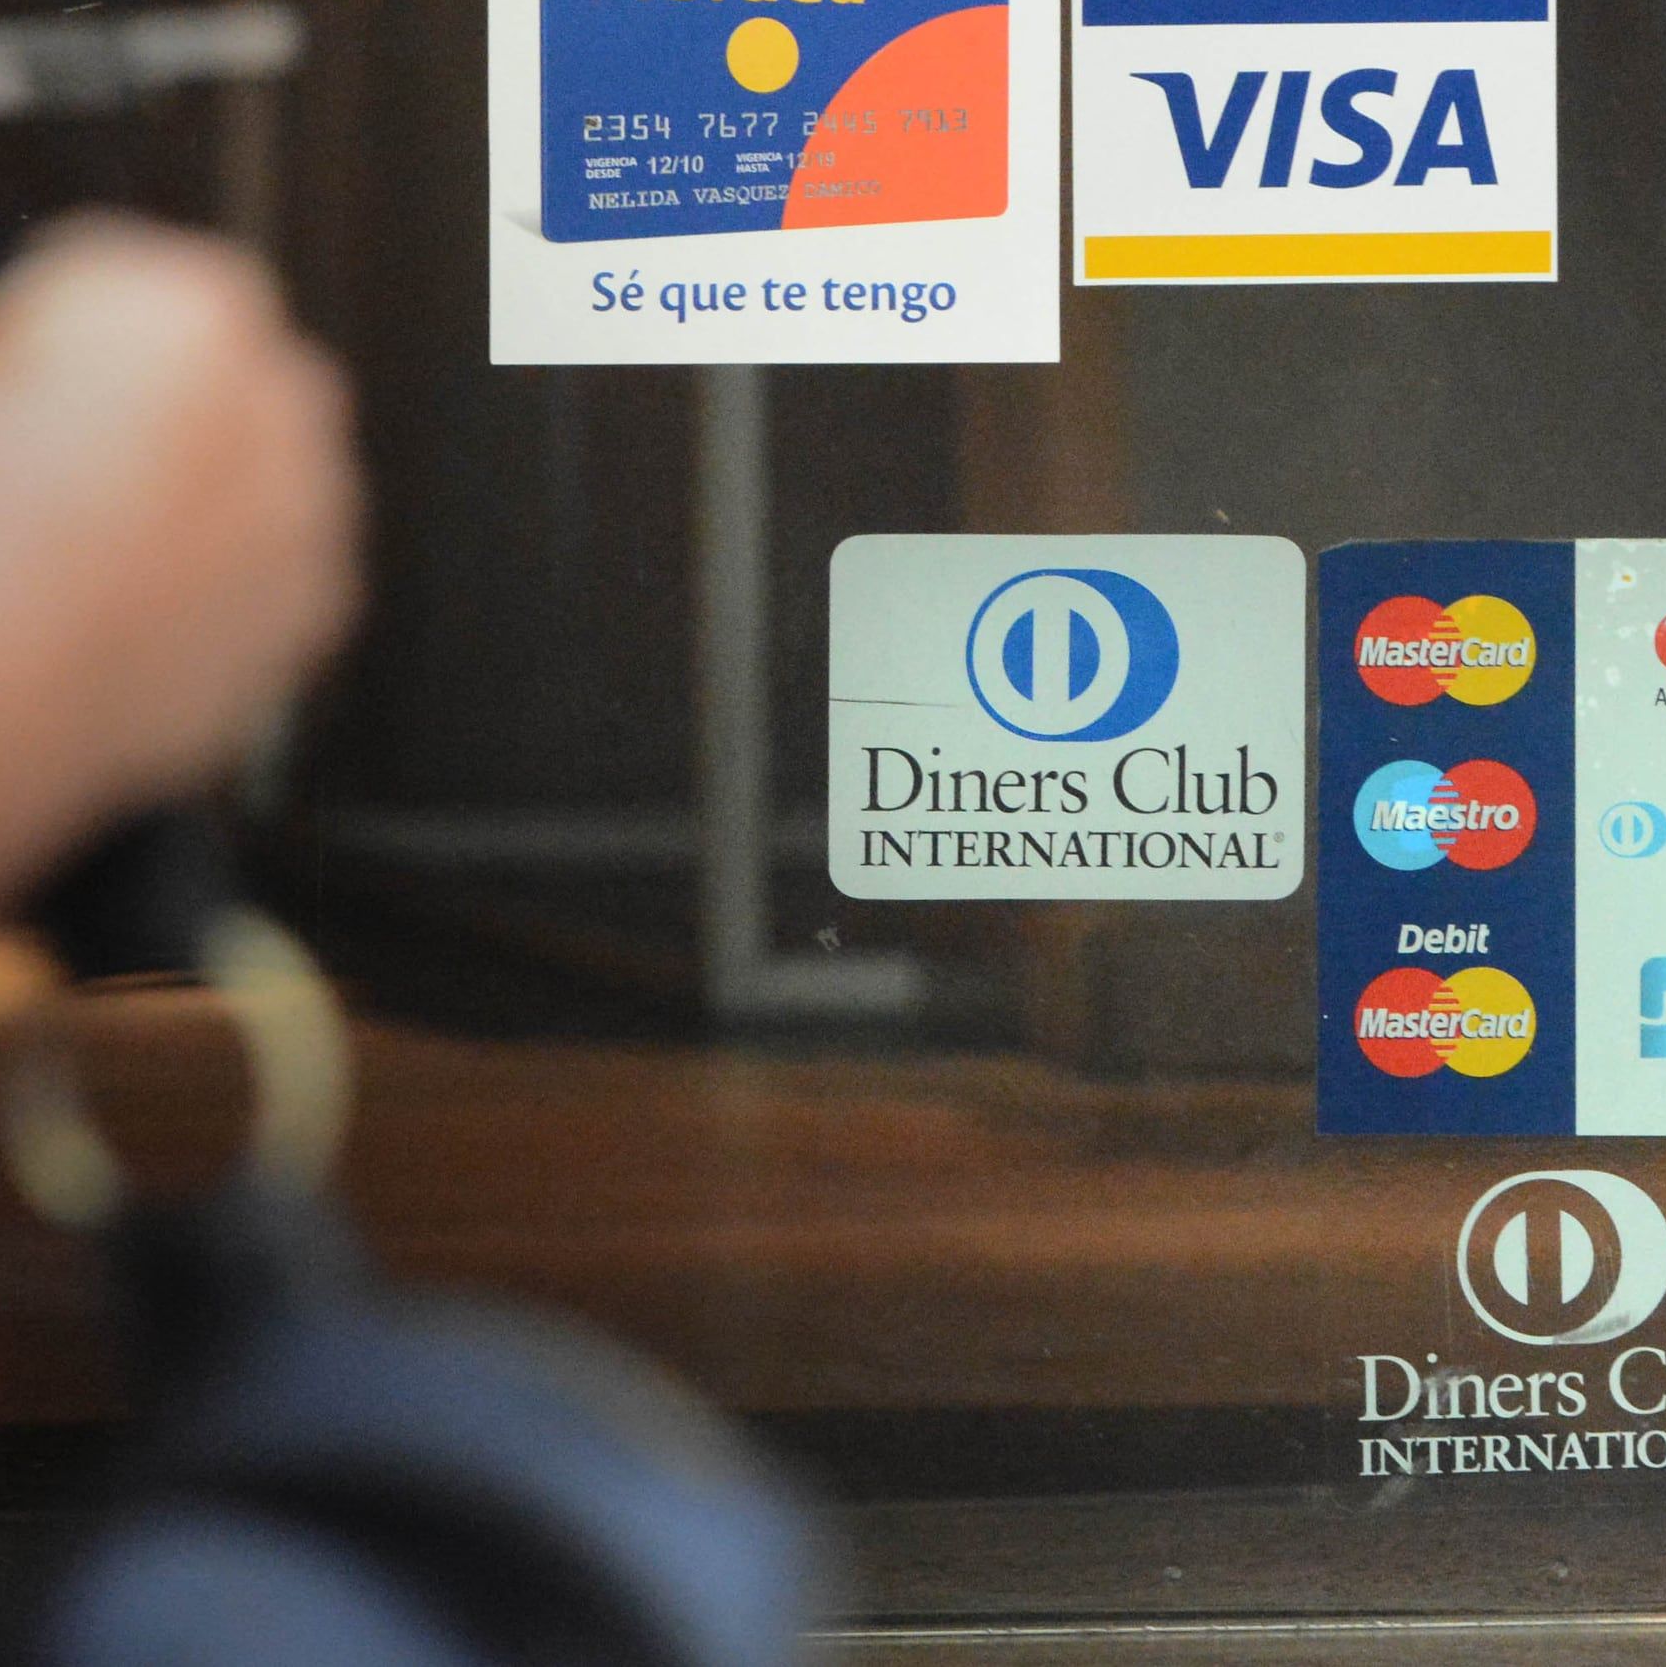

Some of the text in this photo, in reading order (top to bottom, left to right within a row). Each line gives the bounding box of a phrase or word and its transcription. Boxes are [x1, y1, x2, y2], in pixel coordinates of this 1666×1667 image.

[584, 113, 671, 141] 2354
[698, 112, 779, 138] 7677
[1129, 68, 1499, 189] VISA
[586, 155, 705, 174] VIGENCIA 12/10
[586, 168, 622, 179] DESDE
[736, 152, 783, 163] VIGENCIA
[736, 163, 770, 174] HASTA
[588, 190, 681, 210] NELIDA
[693, 184, 790, 206] VASQUEZ
[592, 270, 957, 323] Sé que te tengo
[1358, 636, 1530, 669] MasterCard
[860, 744, 1279, 815] Diners Club
[1370, 799, 1521, 833] Maestro
[859, 830, 1280, 869] INTERNATIONAL
[1397, 923, 1491, 955] Debit
[1358, 1007, 1530, 1041] MasterCard
[1356, 1352, 1586, 1422] Diners
